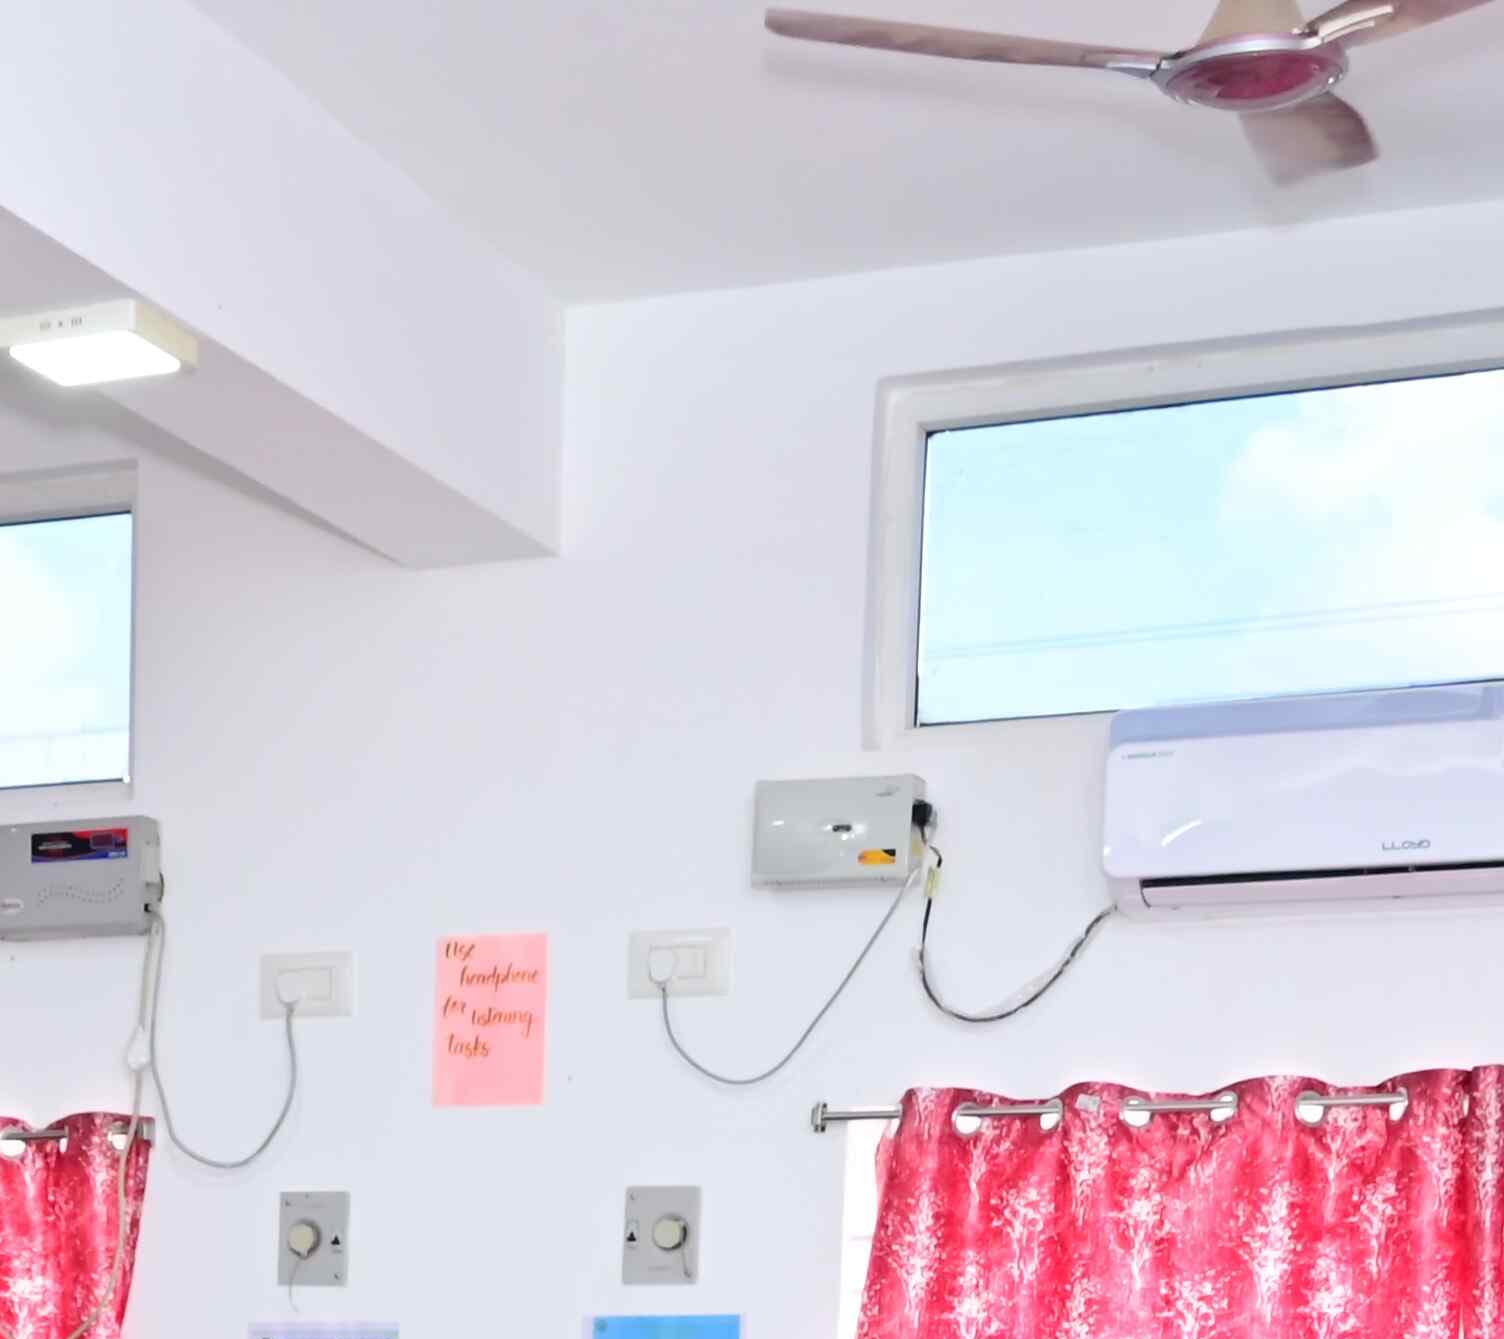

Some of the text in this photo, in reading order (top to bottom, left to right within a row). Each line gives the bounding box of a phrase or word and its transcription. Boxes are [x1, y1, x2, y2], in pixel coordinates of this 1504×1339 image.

[1382, 840, 1430, 850] LLOYD
[443, 995, 467, 1017] for
[448, 1032, 489, 1059] tasks
